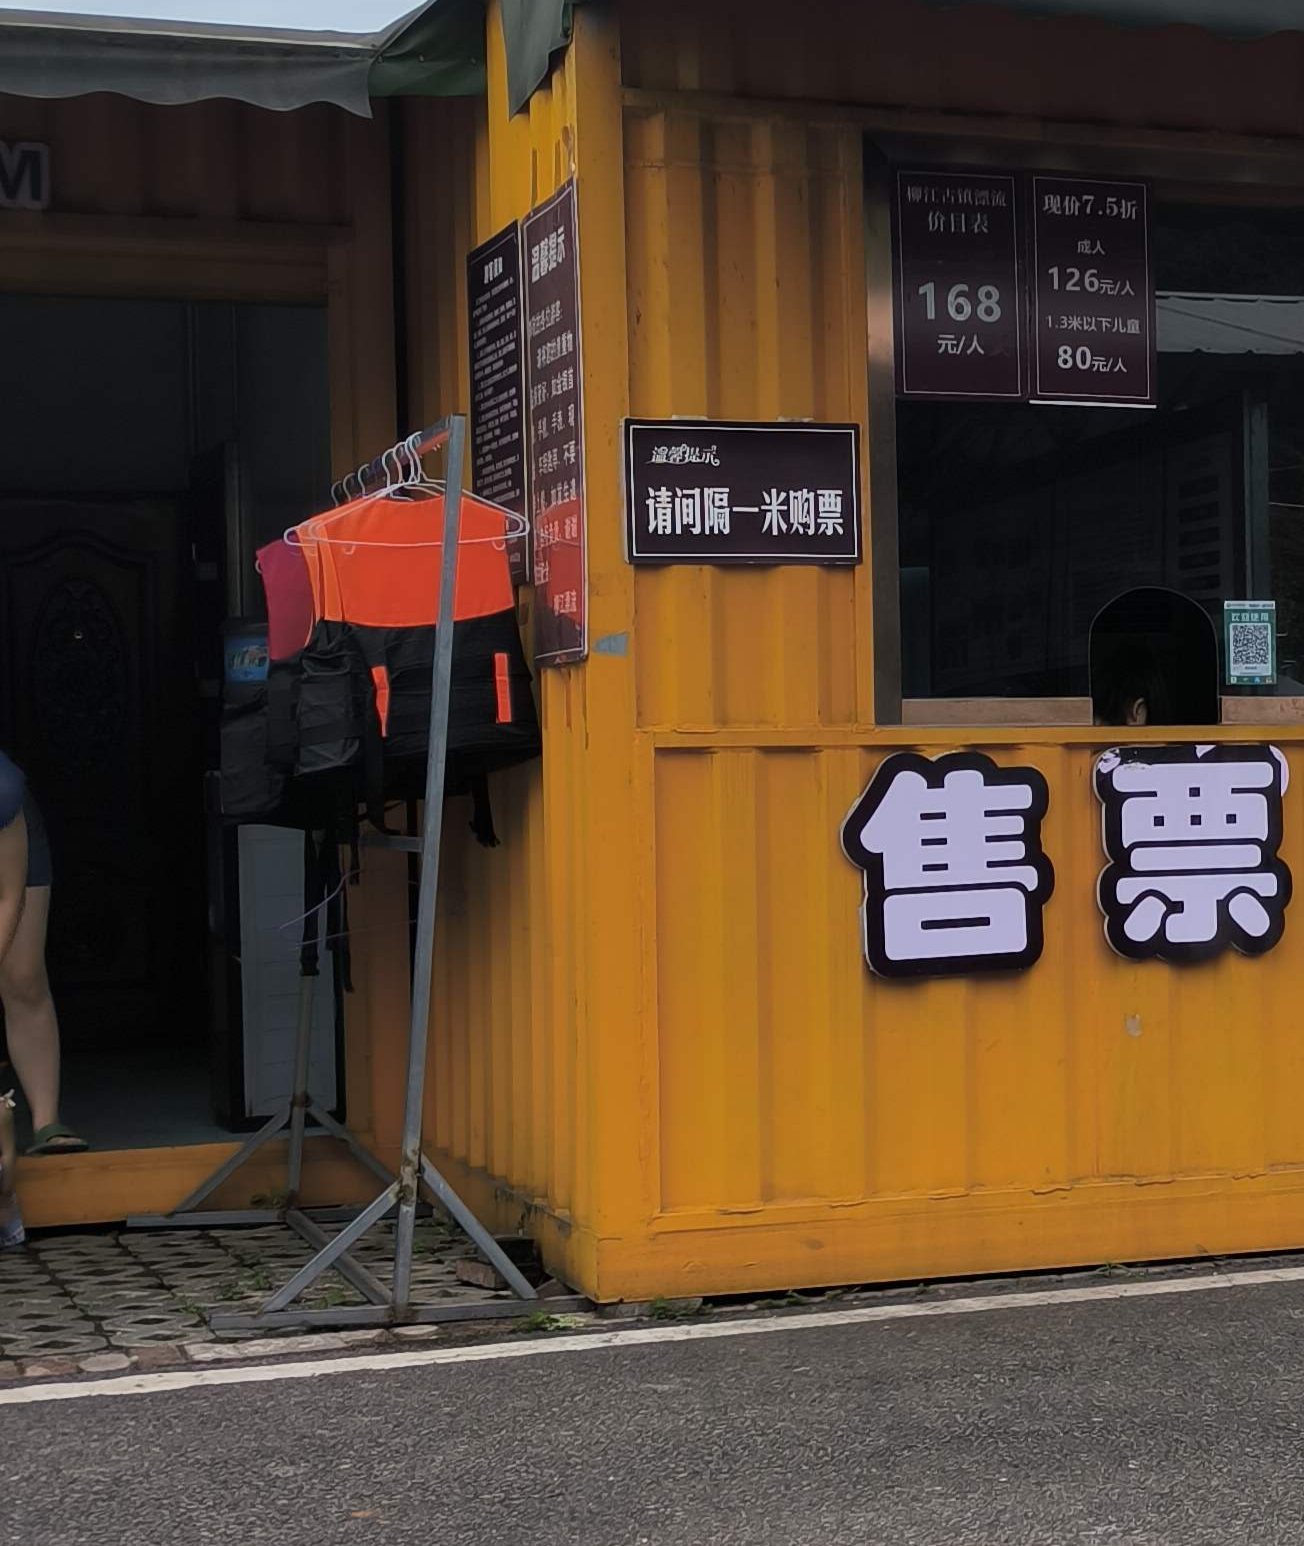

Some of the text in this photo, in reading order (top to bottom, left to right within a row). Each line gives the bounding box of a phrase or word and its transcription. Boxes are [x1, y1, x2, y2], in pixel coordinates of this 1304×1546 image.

[1043, 194, 1138, 221] 现价7.5折
[1077, 239, 1106, 256] 成人
[1048, 267, 1136, 296] 126元/人
[918, 282, 1002, 323] 168
[1046, 315, 1141, 334] 1.3米以下儿童
[937, 334, 985, 355] 元/人
[1057, 345, 1128, 372] 80元/人
[646, 486, 844, 536] 请间隔一米购票
